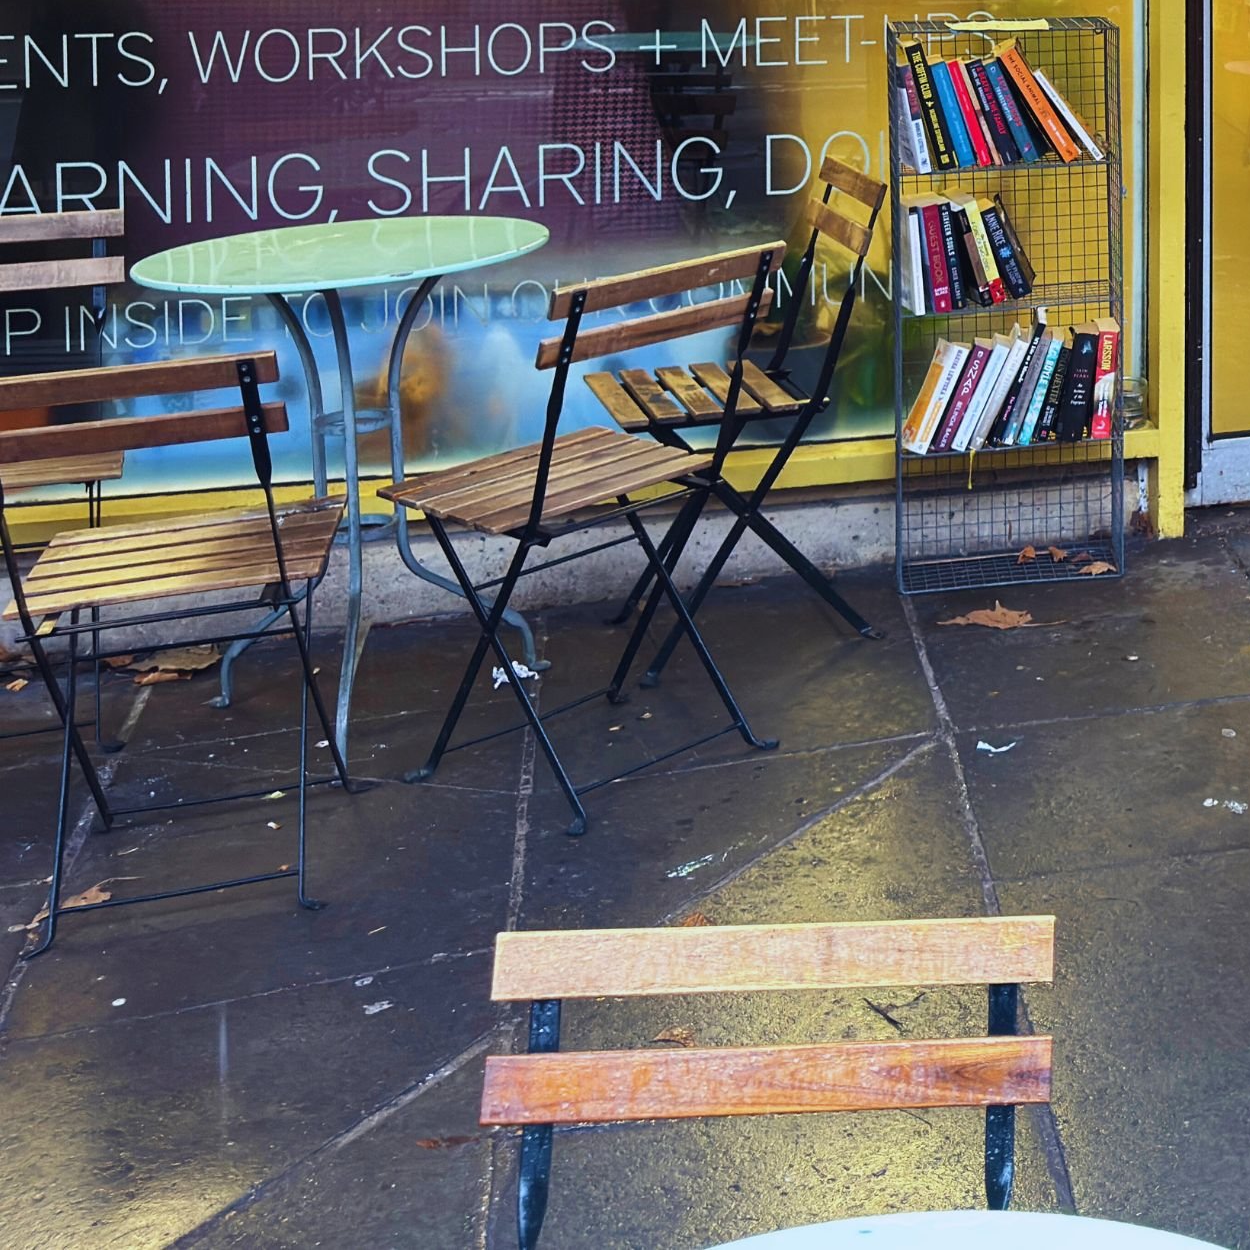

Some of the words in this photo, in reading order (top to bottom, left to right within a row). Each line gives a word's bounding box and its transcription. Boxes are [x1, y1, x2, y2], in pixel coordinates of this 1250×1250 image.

[188, 20, 617, 84] WORKSHOPS
[911, 51, 922, 64] THE
[914, 62, 928, 84] COFFIN
[1013, 63, 1028, 83] SOCIAL
[1025, 83, 1040, 104] ANIMAL
[920, 83, 931, 98] CLUB
[0, 153, 338, 225] ARNING,
[367, 136, 737, 211] SHARING,
[928, 220, 939, 252] GUEST
[983, 211, 1000, 232] ANNE
[946, 236, 954, 255] SOULS
[991, 228, 1007, 246] RICE
[932, 254, 943, 283] BOOK
[65, 296, 253, 352] INSIDE
[361, 283, 488, 334] JOIN
[1100, 334, 1113, 370] LARSSON
[960, 358, 980, 397] SNAP
[1047, 373, 1063, 404] DEXTER
[948, 400, 962, 427] BELINDA
[939, 427, 951, 448] BAUER
